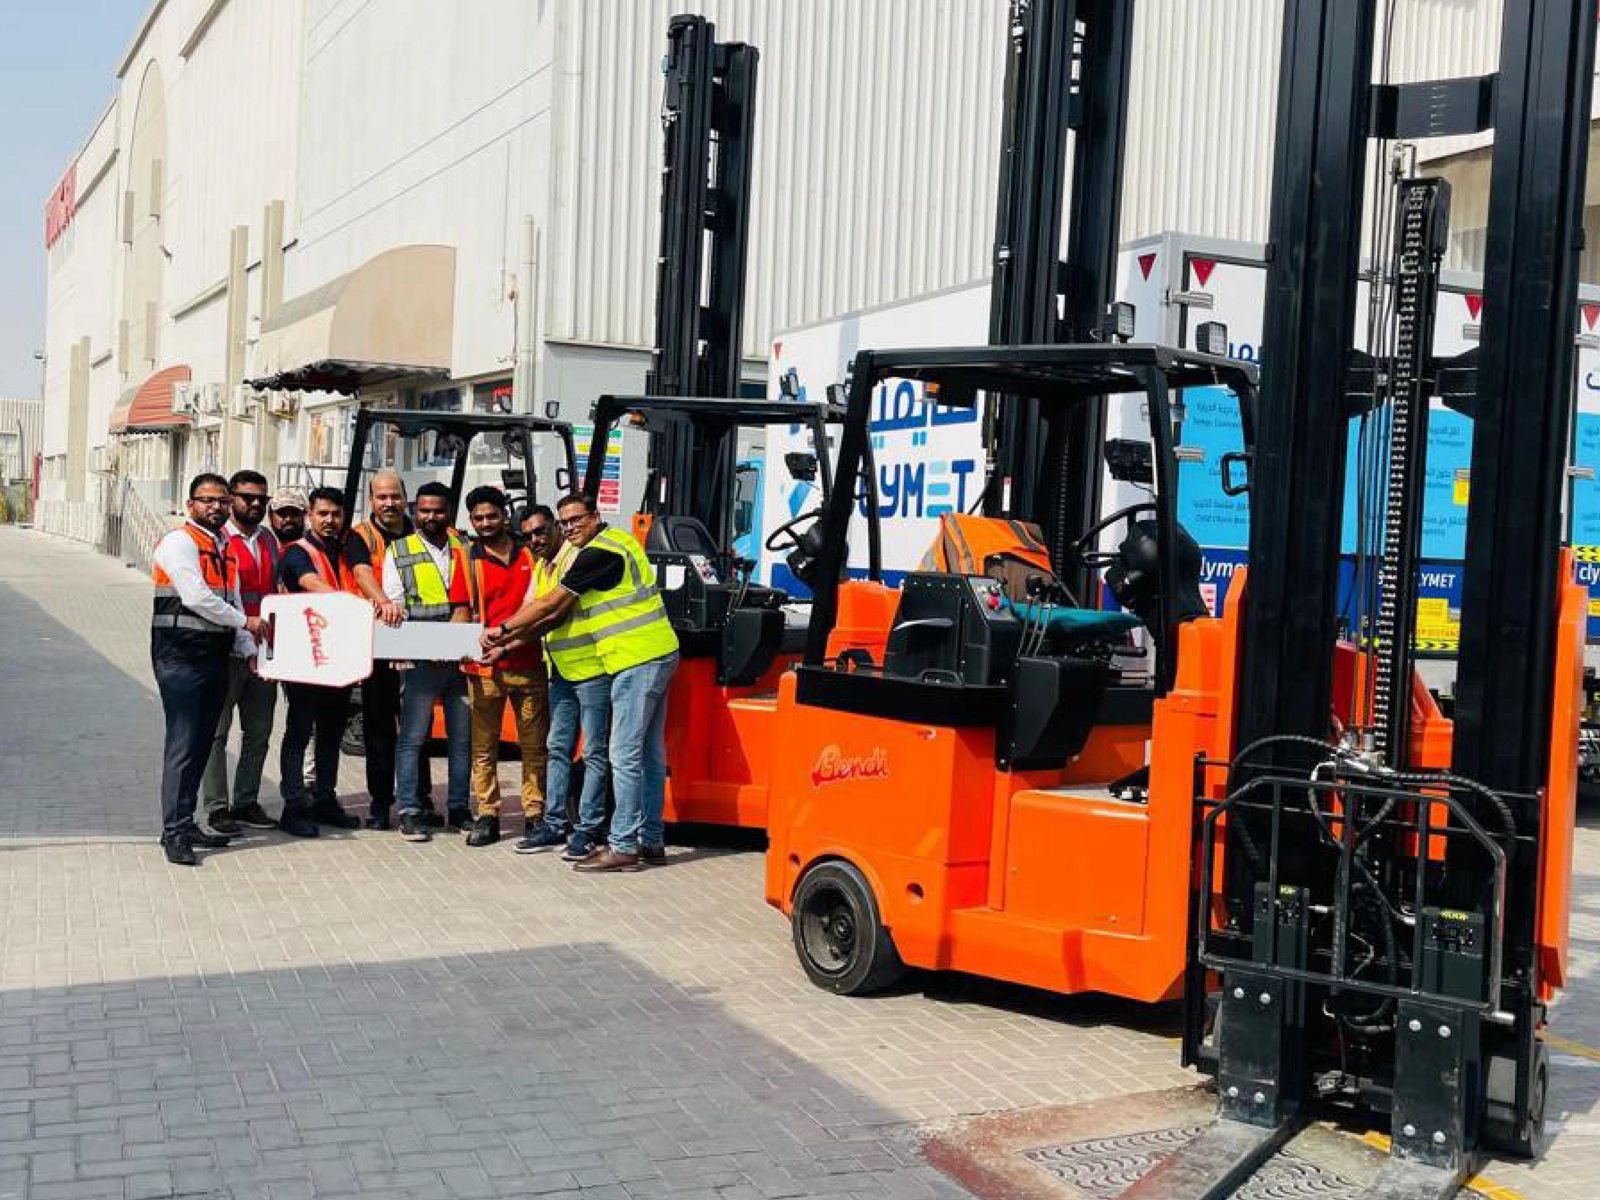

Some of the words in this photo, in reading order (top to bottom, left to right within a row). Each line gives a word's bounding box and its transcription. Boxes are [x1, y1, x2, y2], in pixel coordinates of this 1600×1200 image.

[1419, 572, 1456, 589] YMET
[1578, 563, 1600, 585] cly
[303, 606, 329, 668] Bendi
[811, 744, 888, 787] Bendi
